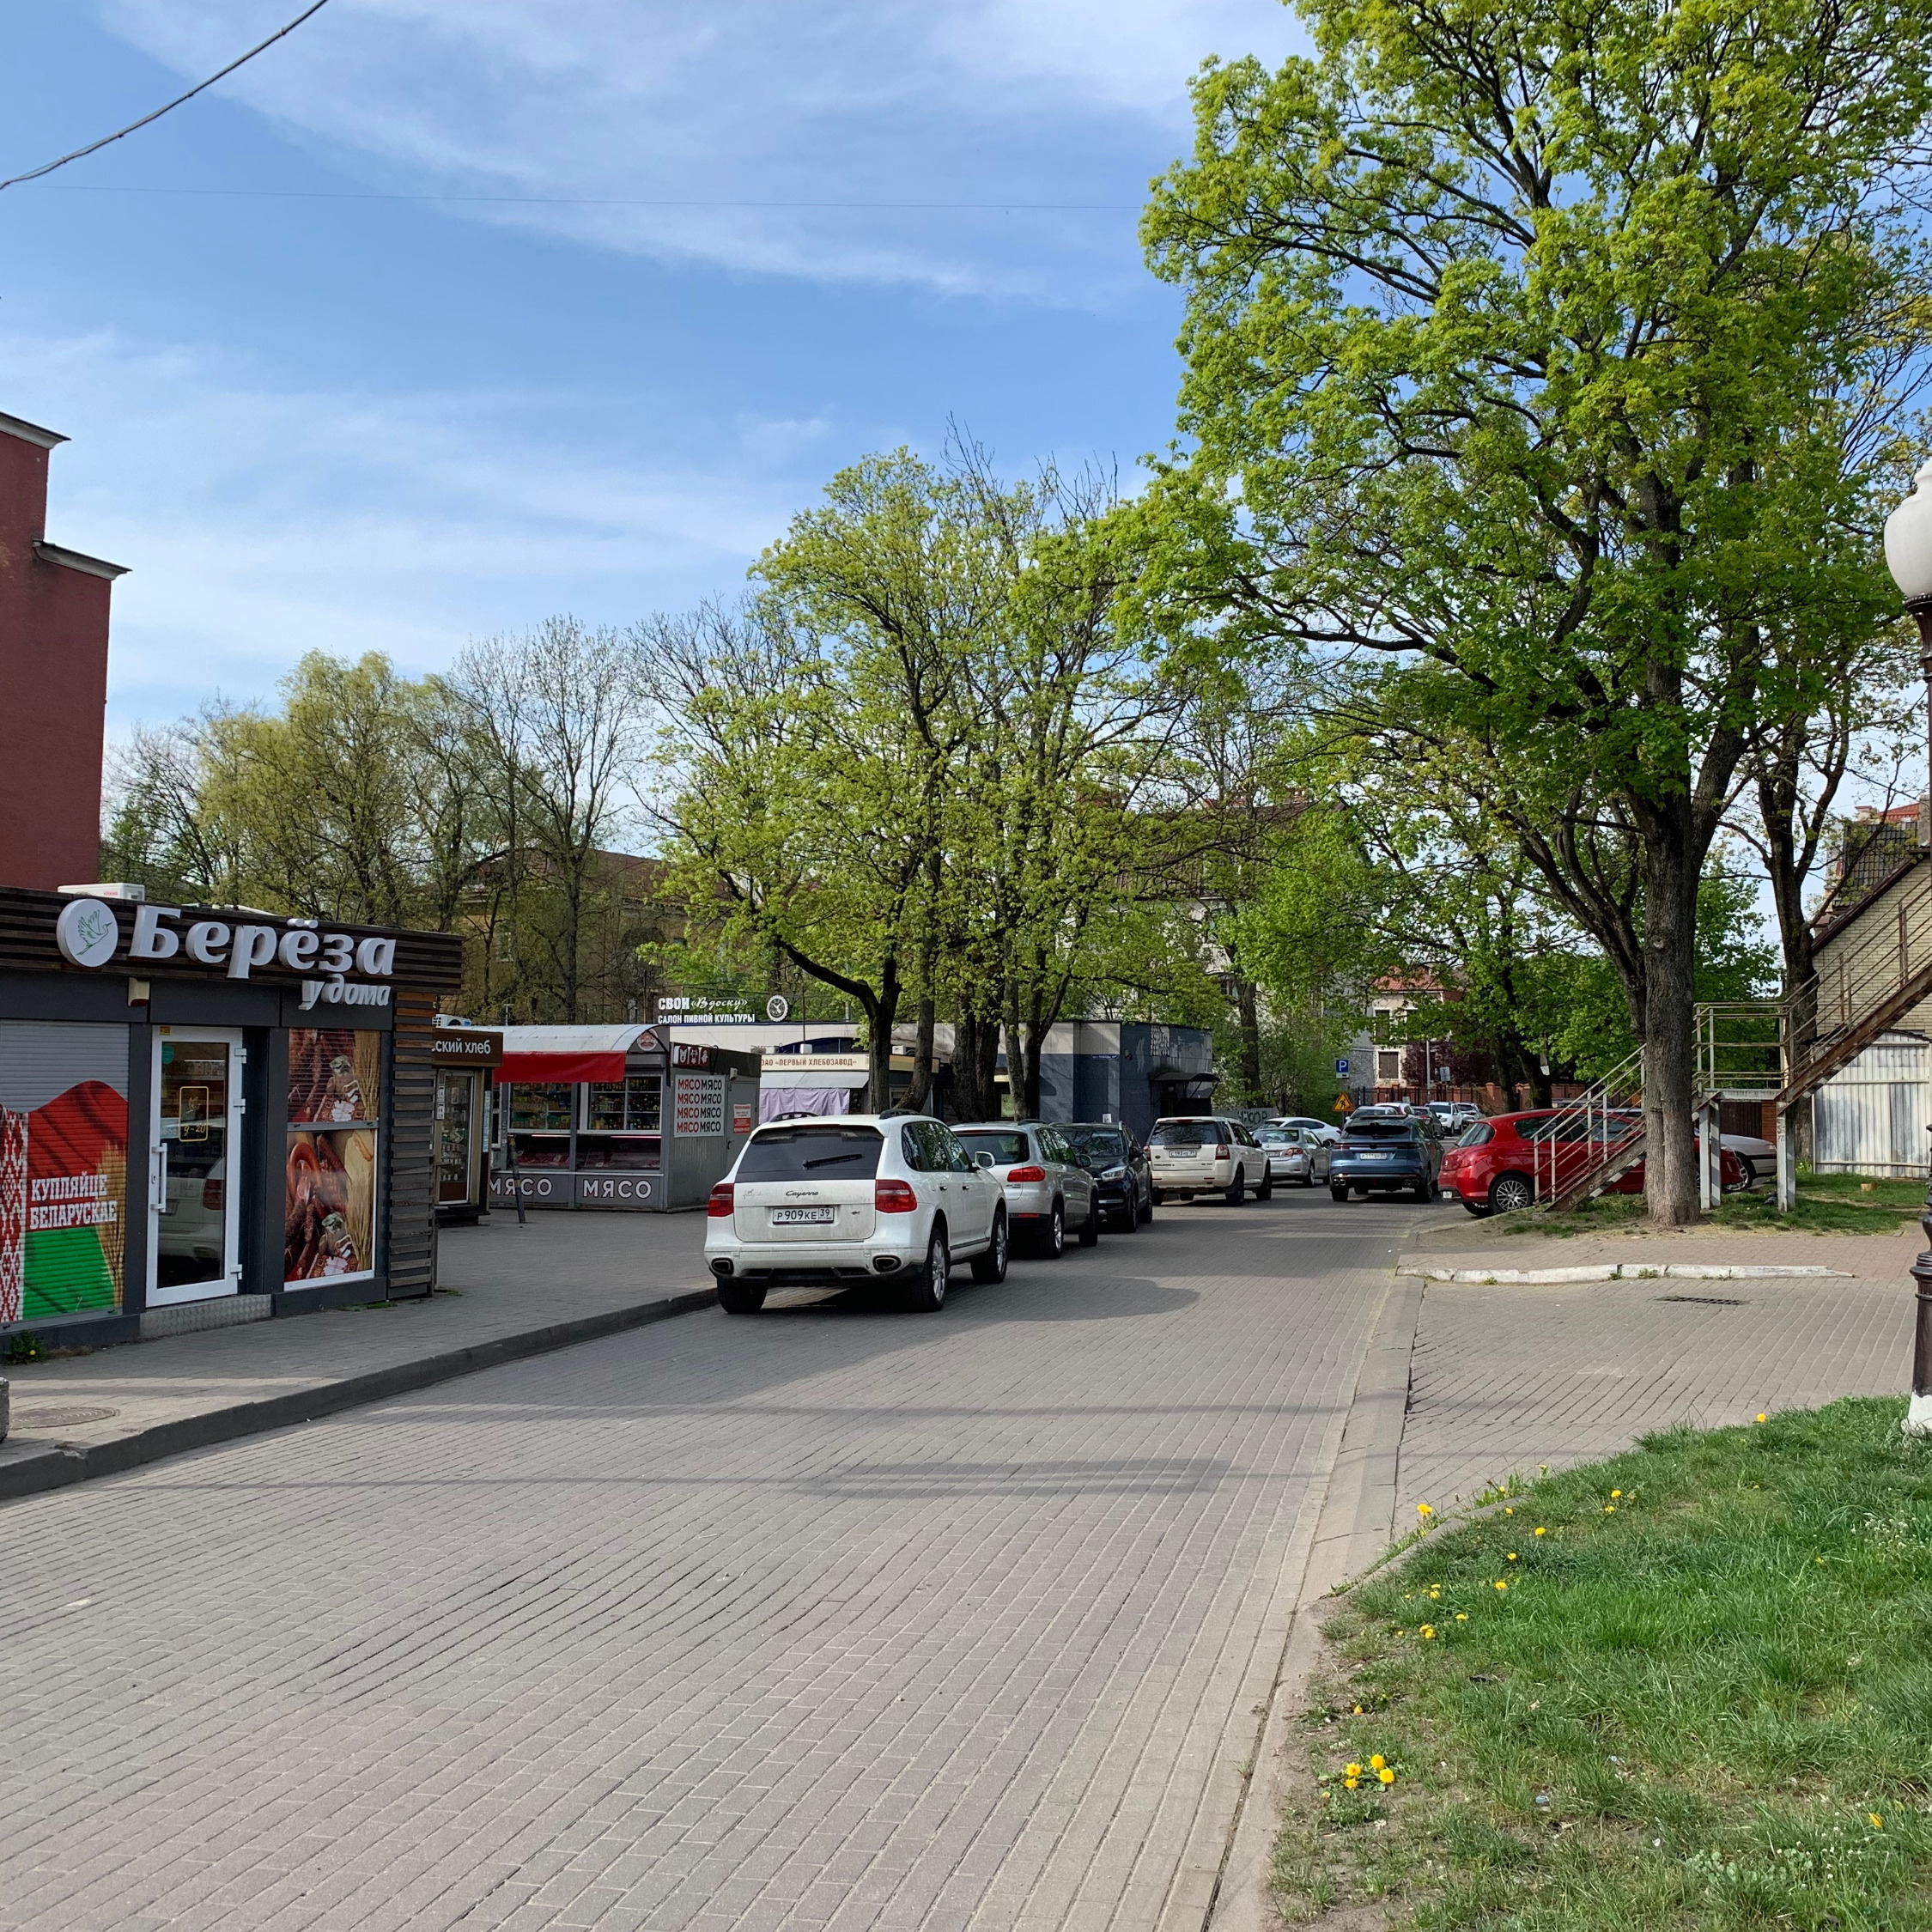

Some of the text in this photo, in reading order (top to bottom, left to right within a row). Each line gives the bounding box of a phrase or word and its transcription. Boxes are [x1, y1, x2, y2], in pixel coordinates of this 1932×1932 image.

[128, 905, 397, 979] Берёза
[658, 1013, 756, 1024] САЛОН ПИВНОЙ КУЛЬТУРЫ
[431, 1038, 491, 1054] ский хлеб
[1340, 1060, 1347, 1072] P
[677, 1079, 722, 1091] МЯСО МЯСО
[677, 1093, 721, 1104] МЯСО МЯСО
[677, 1108, 700, 1119] МЯСО
[700, 1108, 721, 1119] МЯСО
[677, 1121, 699, 1133] МЯСО
[700, 1121, 721, 1133] МЯСО
[31, 1170, 107, 1201] КУПЛЯЙЦЕ
[489, 1178, 653, 1199] МЯСО МЯСО
[30, 1200, 118, 1230] БЕЛАРУСКАЕ
